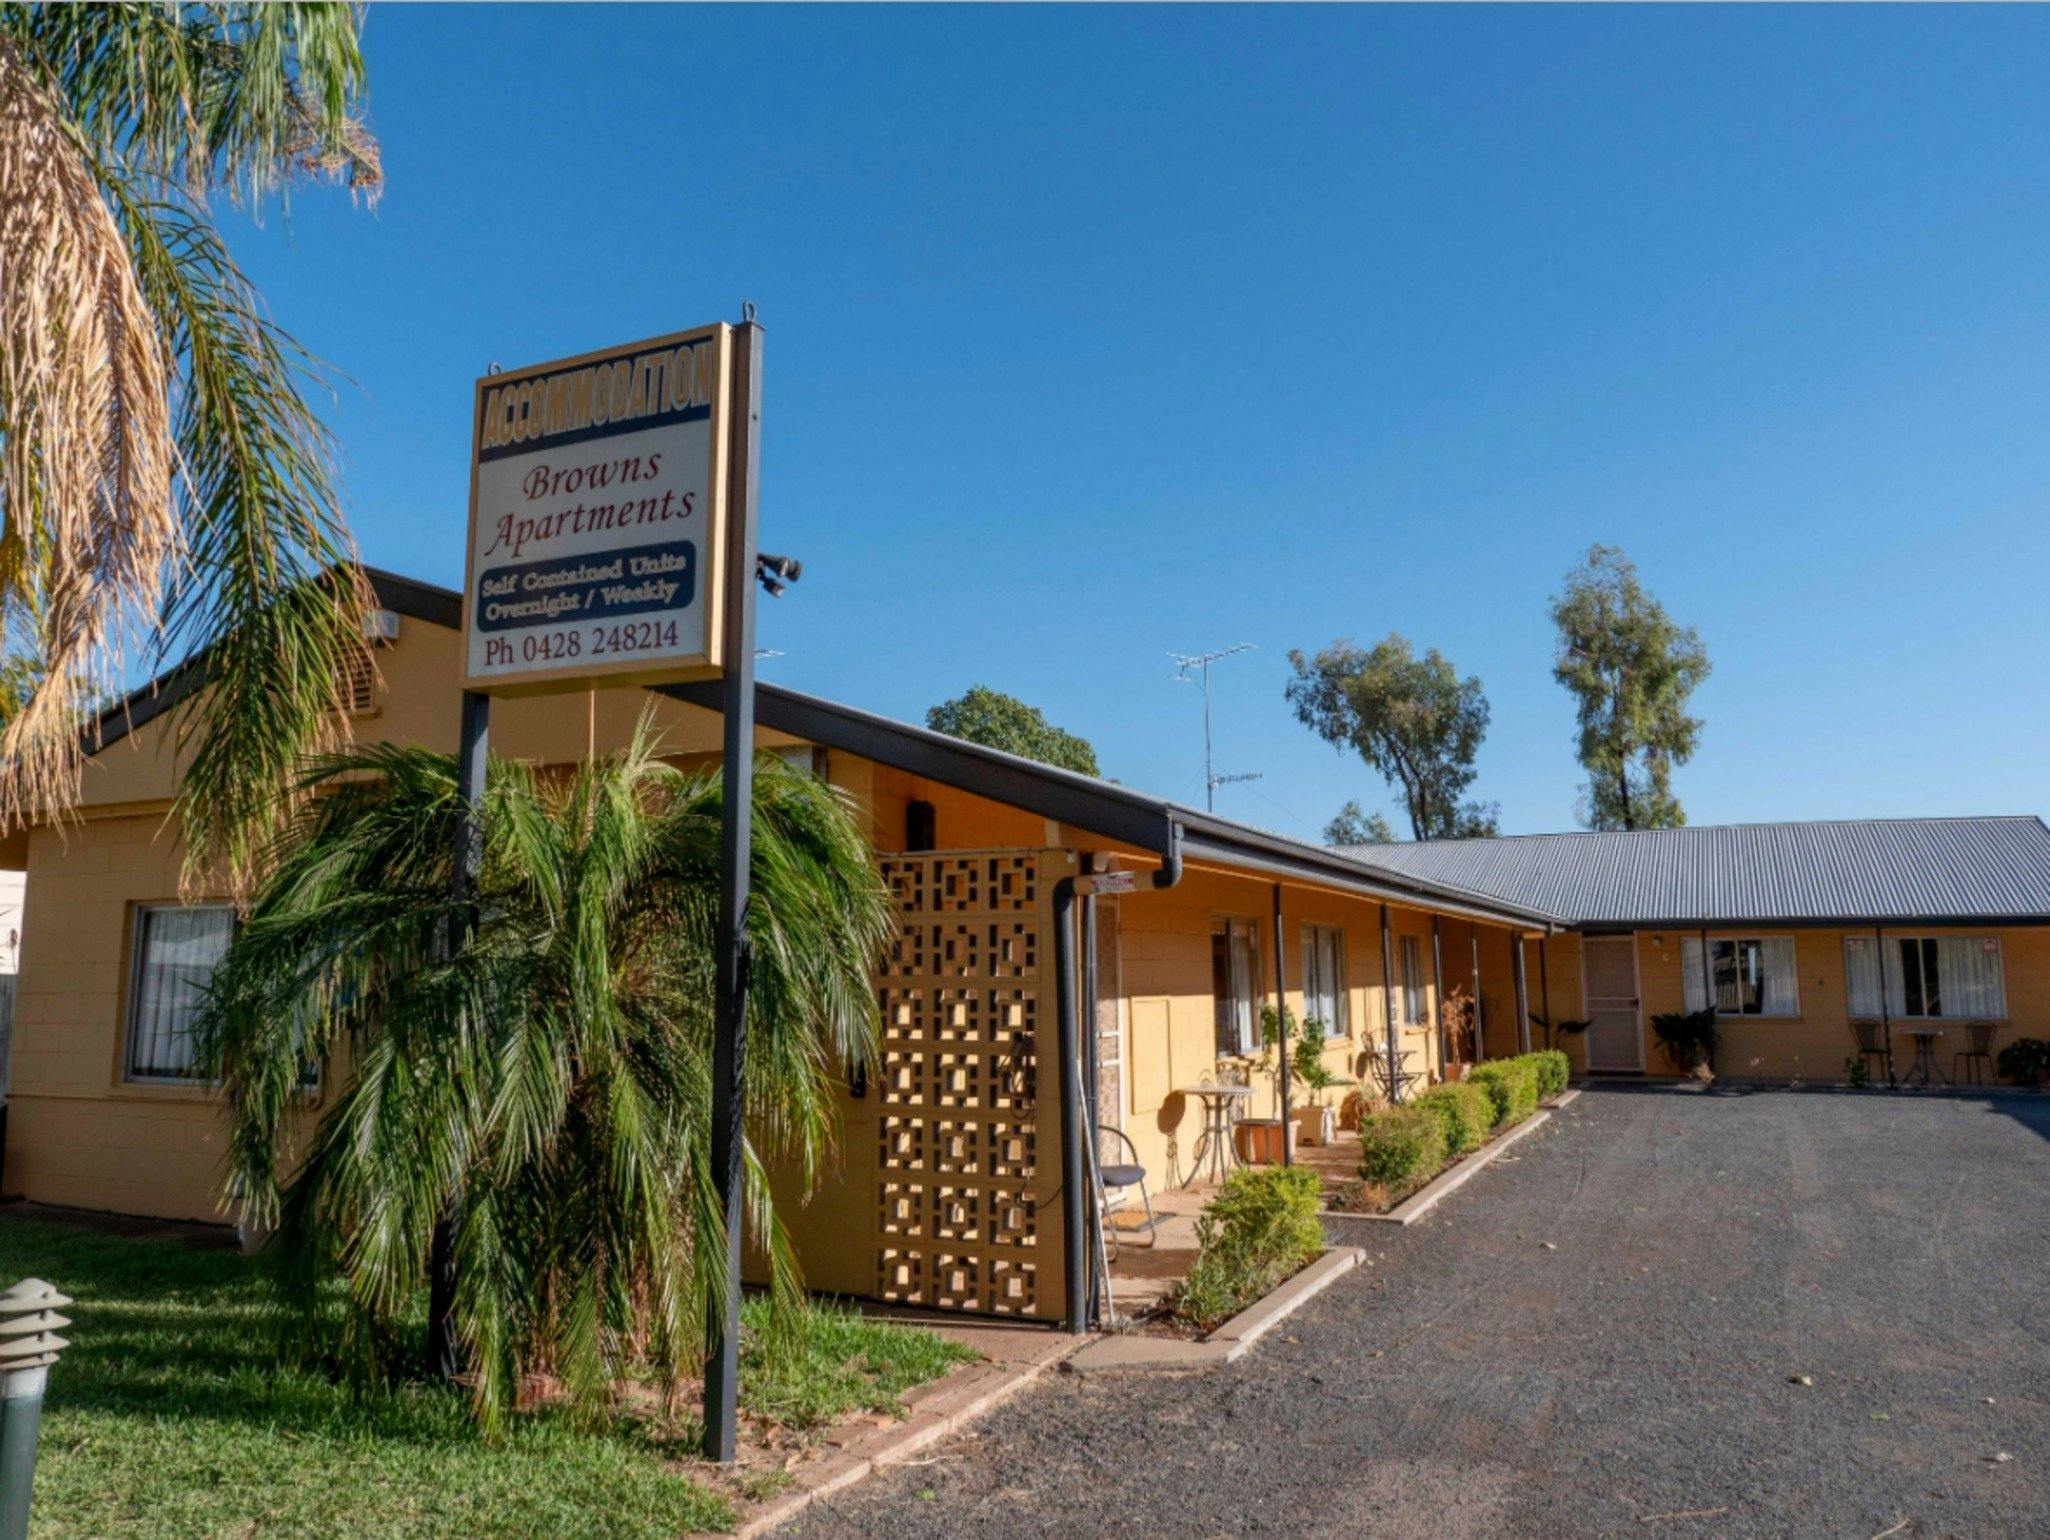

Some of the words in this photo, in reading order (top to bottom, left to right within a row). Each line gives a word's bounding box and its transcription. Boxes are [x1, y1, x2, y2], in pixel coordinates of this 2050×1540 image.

[481, 341, 713, 449] ACCOMMODATION
[523, 452, 662, 501] Browns
[485, 490, 696, 558] Apartments
[482, 574, 518, 598] Self
[522, 558, 624, 591] Contained
[629, 552, 687, 576] Units
[485, 592, 580, 621] Overnight
[583, 588, 595, 609] /
[601, 578, 680, 605] Weekly
[484, 636, 514, 666] Ph
[523, 630, 581, 662] 0428
[591, 619, 679, 655] 248214
